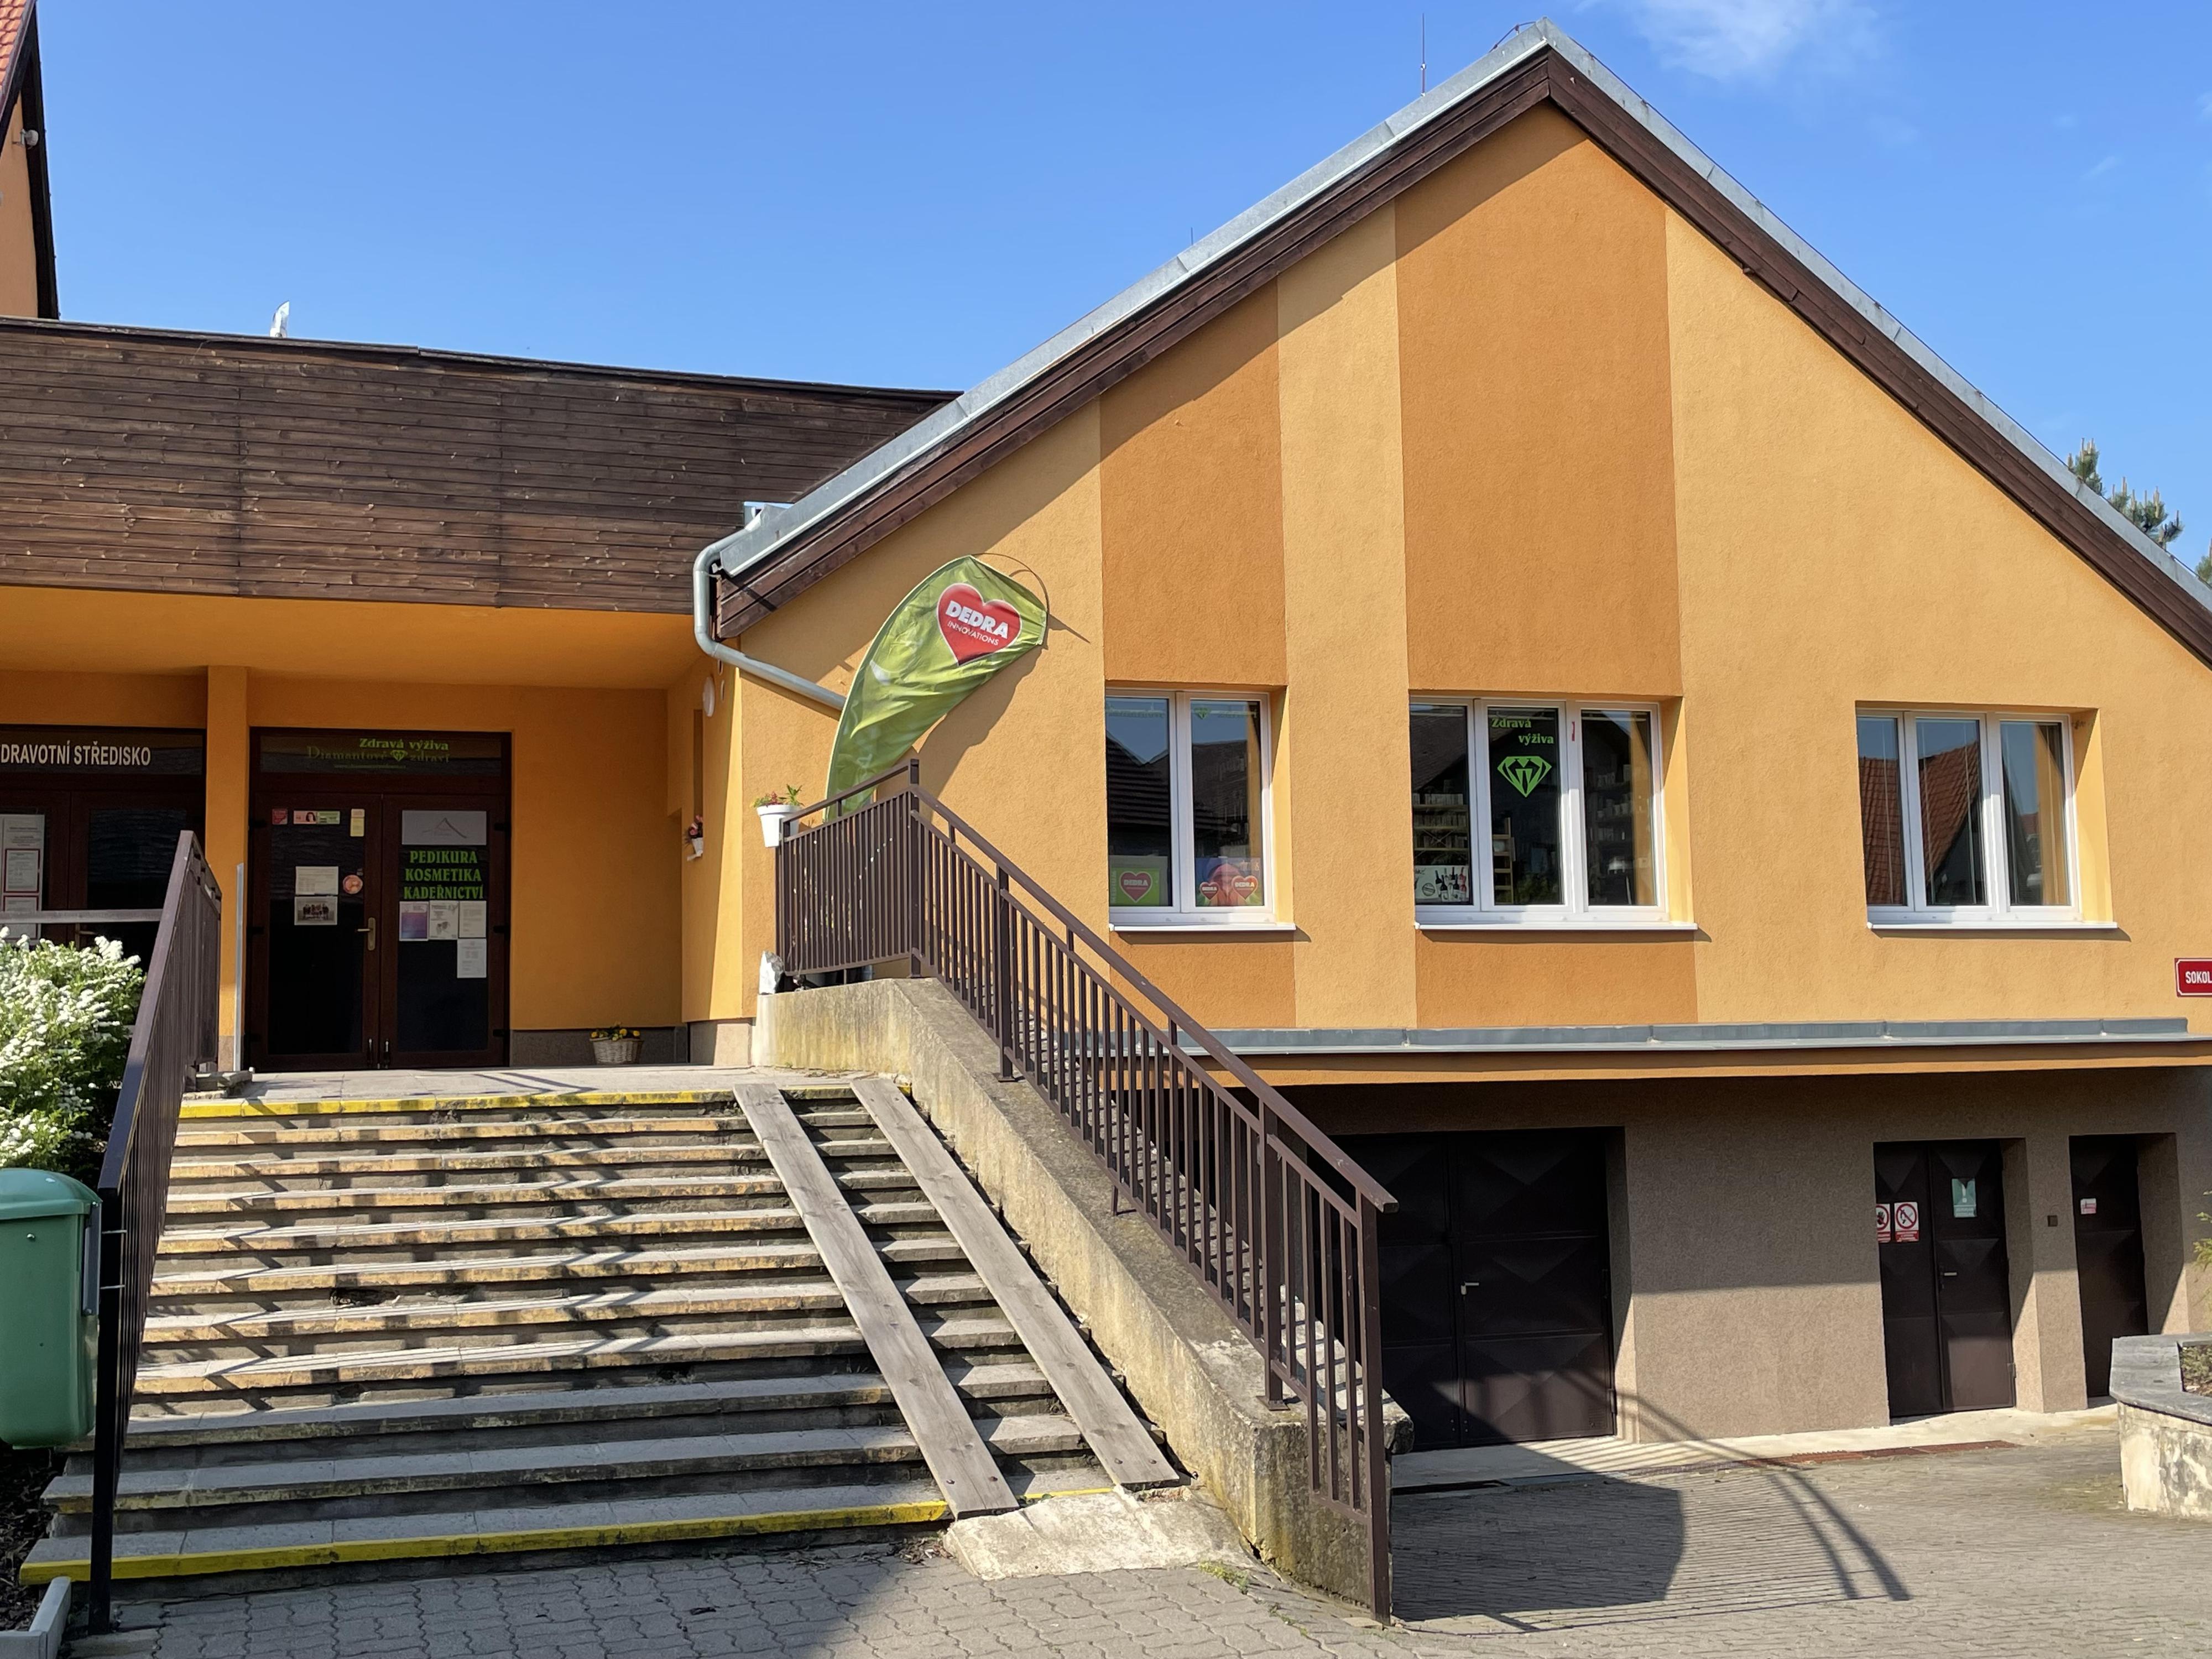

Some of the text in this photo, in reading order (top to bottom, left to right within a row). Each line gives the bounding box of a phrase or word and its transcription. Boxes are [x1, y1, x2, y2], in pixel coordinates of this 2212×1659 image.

[945, 600, 1009, 640] DEDRA
[947, 620, 1000, 646] INNOVATIONS
[1491, 718, 1531, 728] Zdravá
[359, 738, 449, 753] Zdravá výživa
[1518, 733, 1554, 746] výživa
[0, 740, 151, 765] DRAVOTNÍ STŘEDISKO
[410, 850, 478, 864] PEDIKURA
[404, 868, 482, 881] KOSMETIKA
[403, 884, 484, 899] KADEŘNICTVÍ
